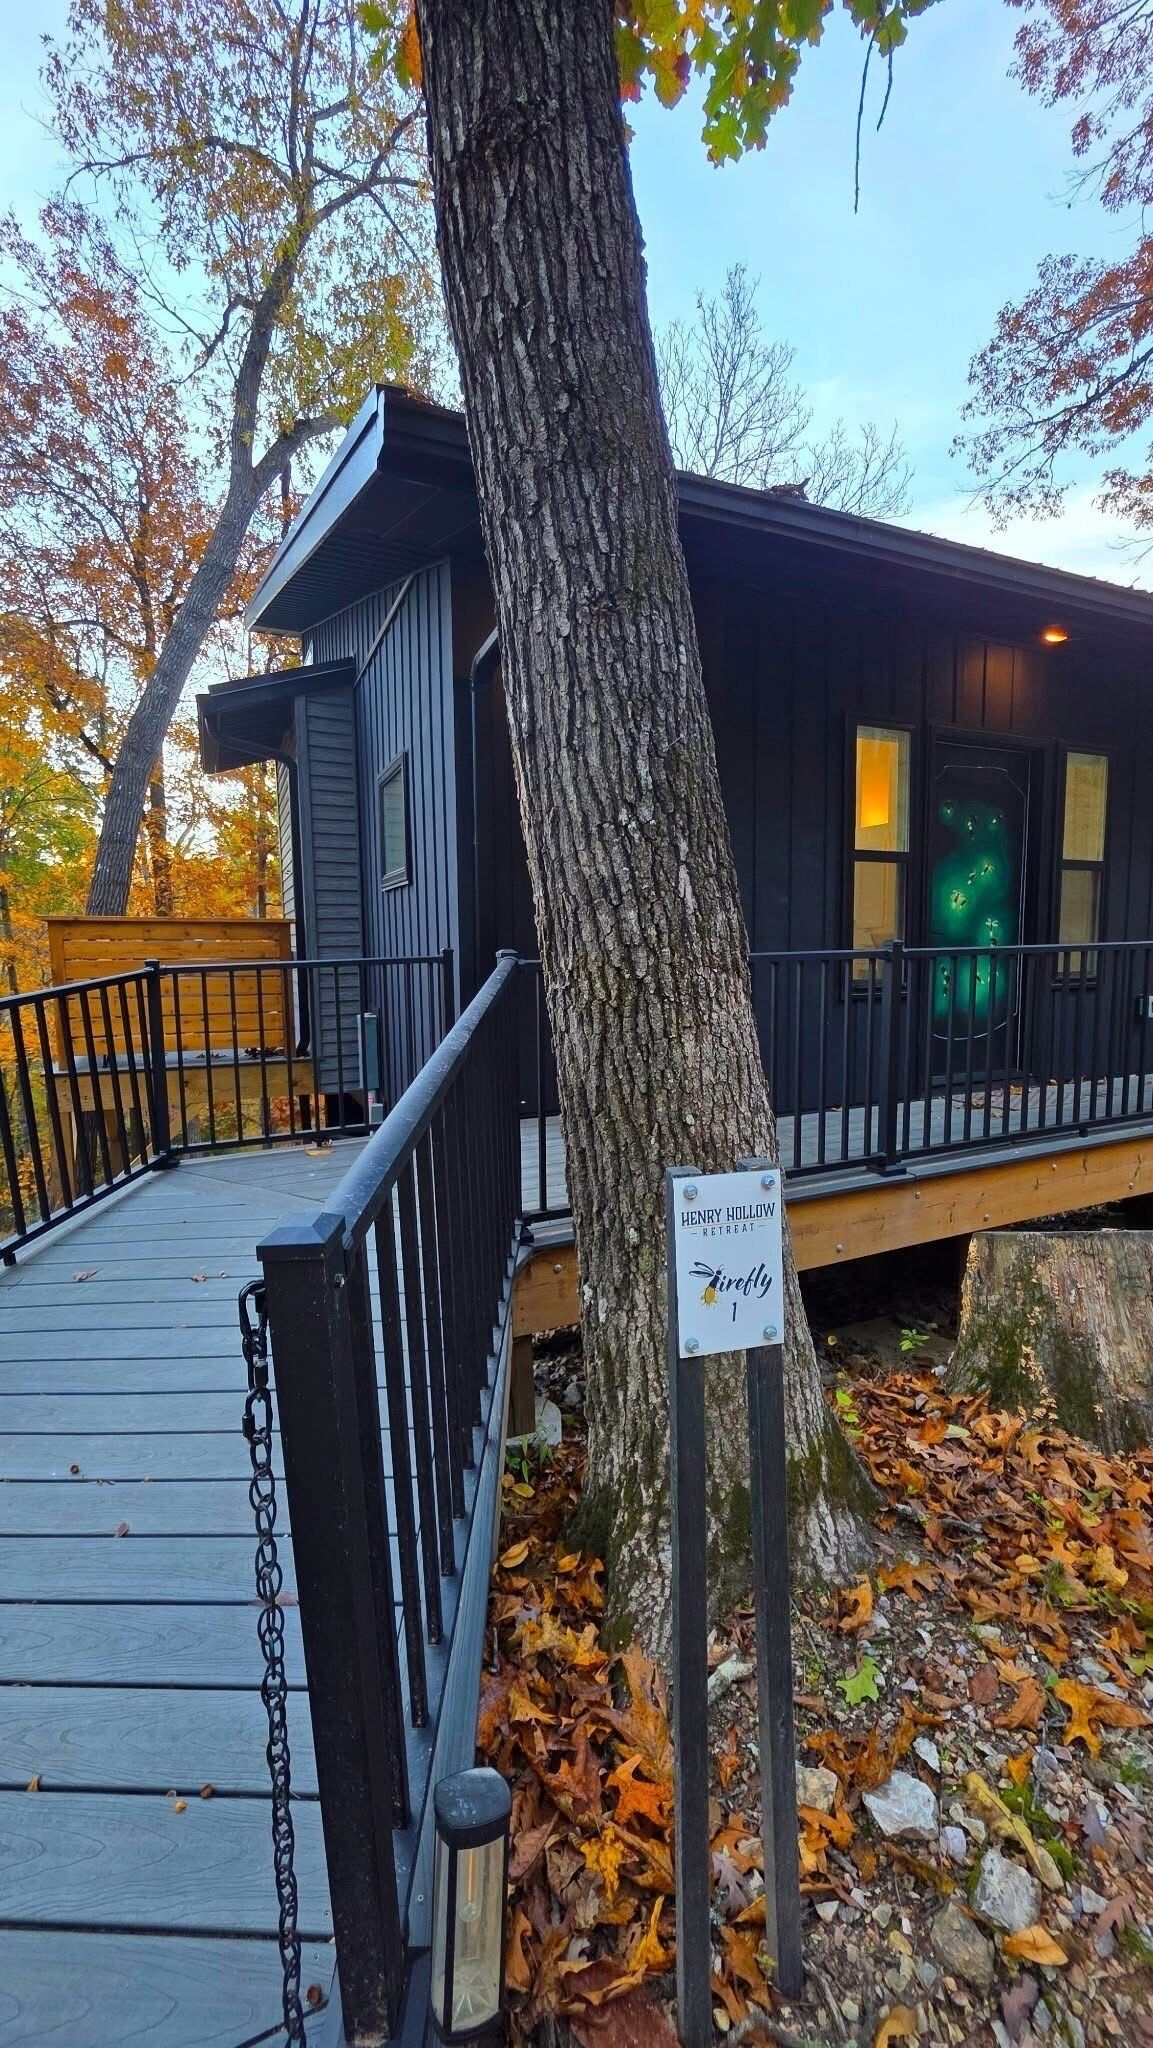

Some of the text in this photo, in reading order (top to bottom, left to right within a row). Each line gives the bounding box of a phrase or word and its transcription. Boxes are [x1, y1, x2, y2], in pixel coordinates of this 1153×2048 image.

[681, 1202, 776, 1227] HENRY HOLLOW
[703, 1223, 755, 1236] RETREAT
[732, 1301, 737, 1322] 1
